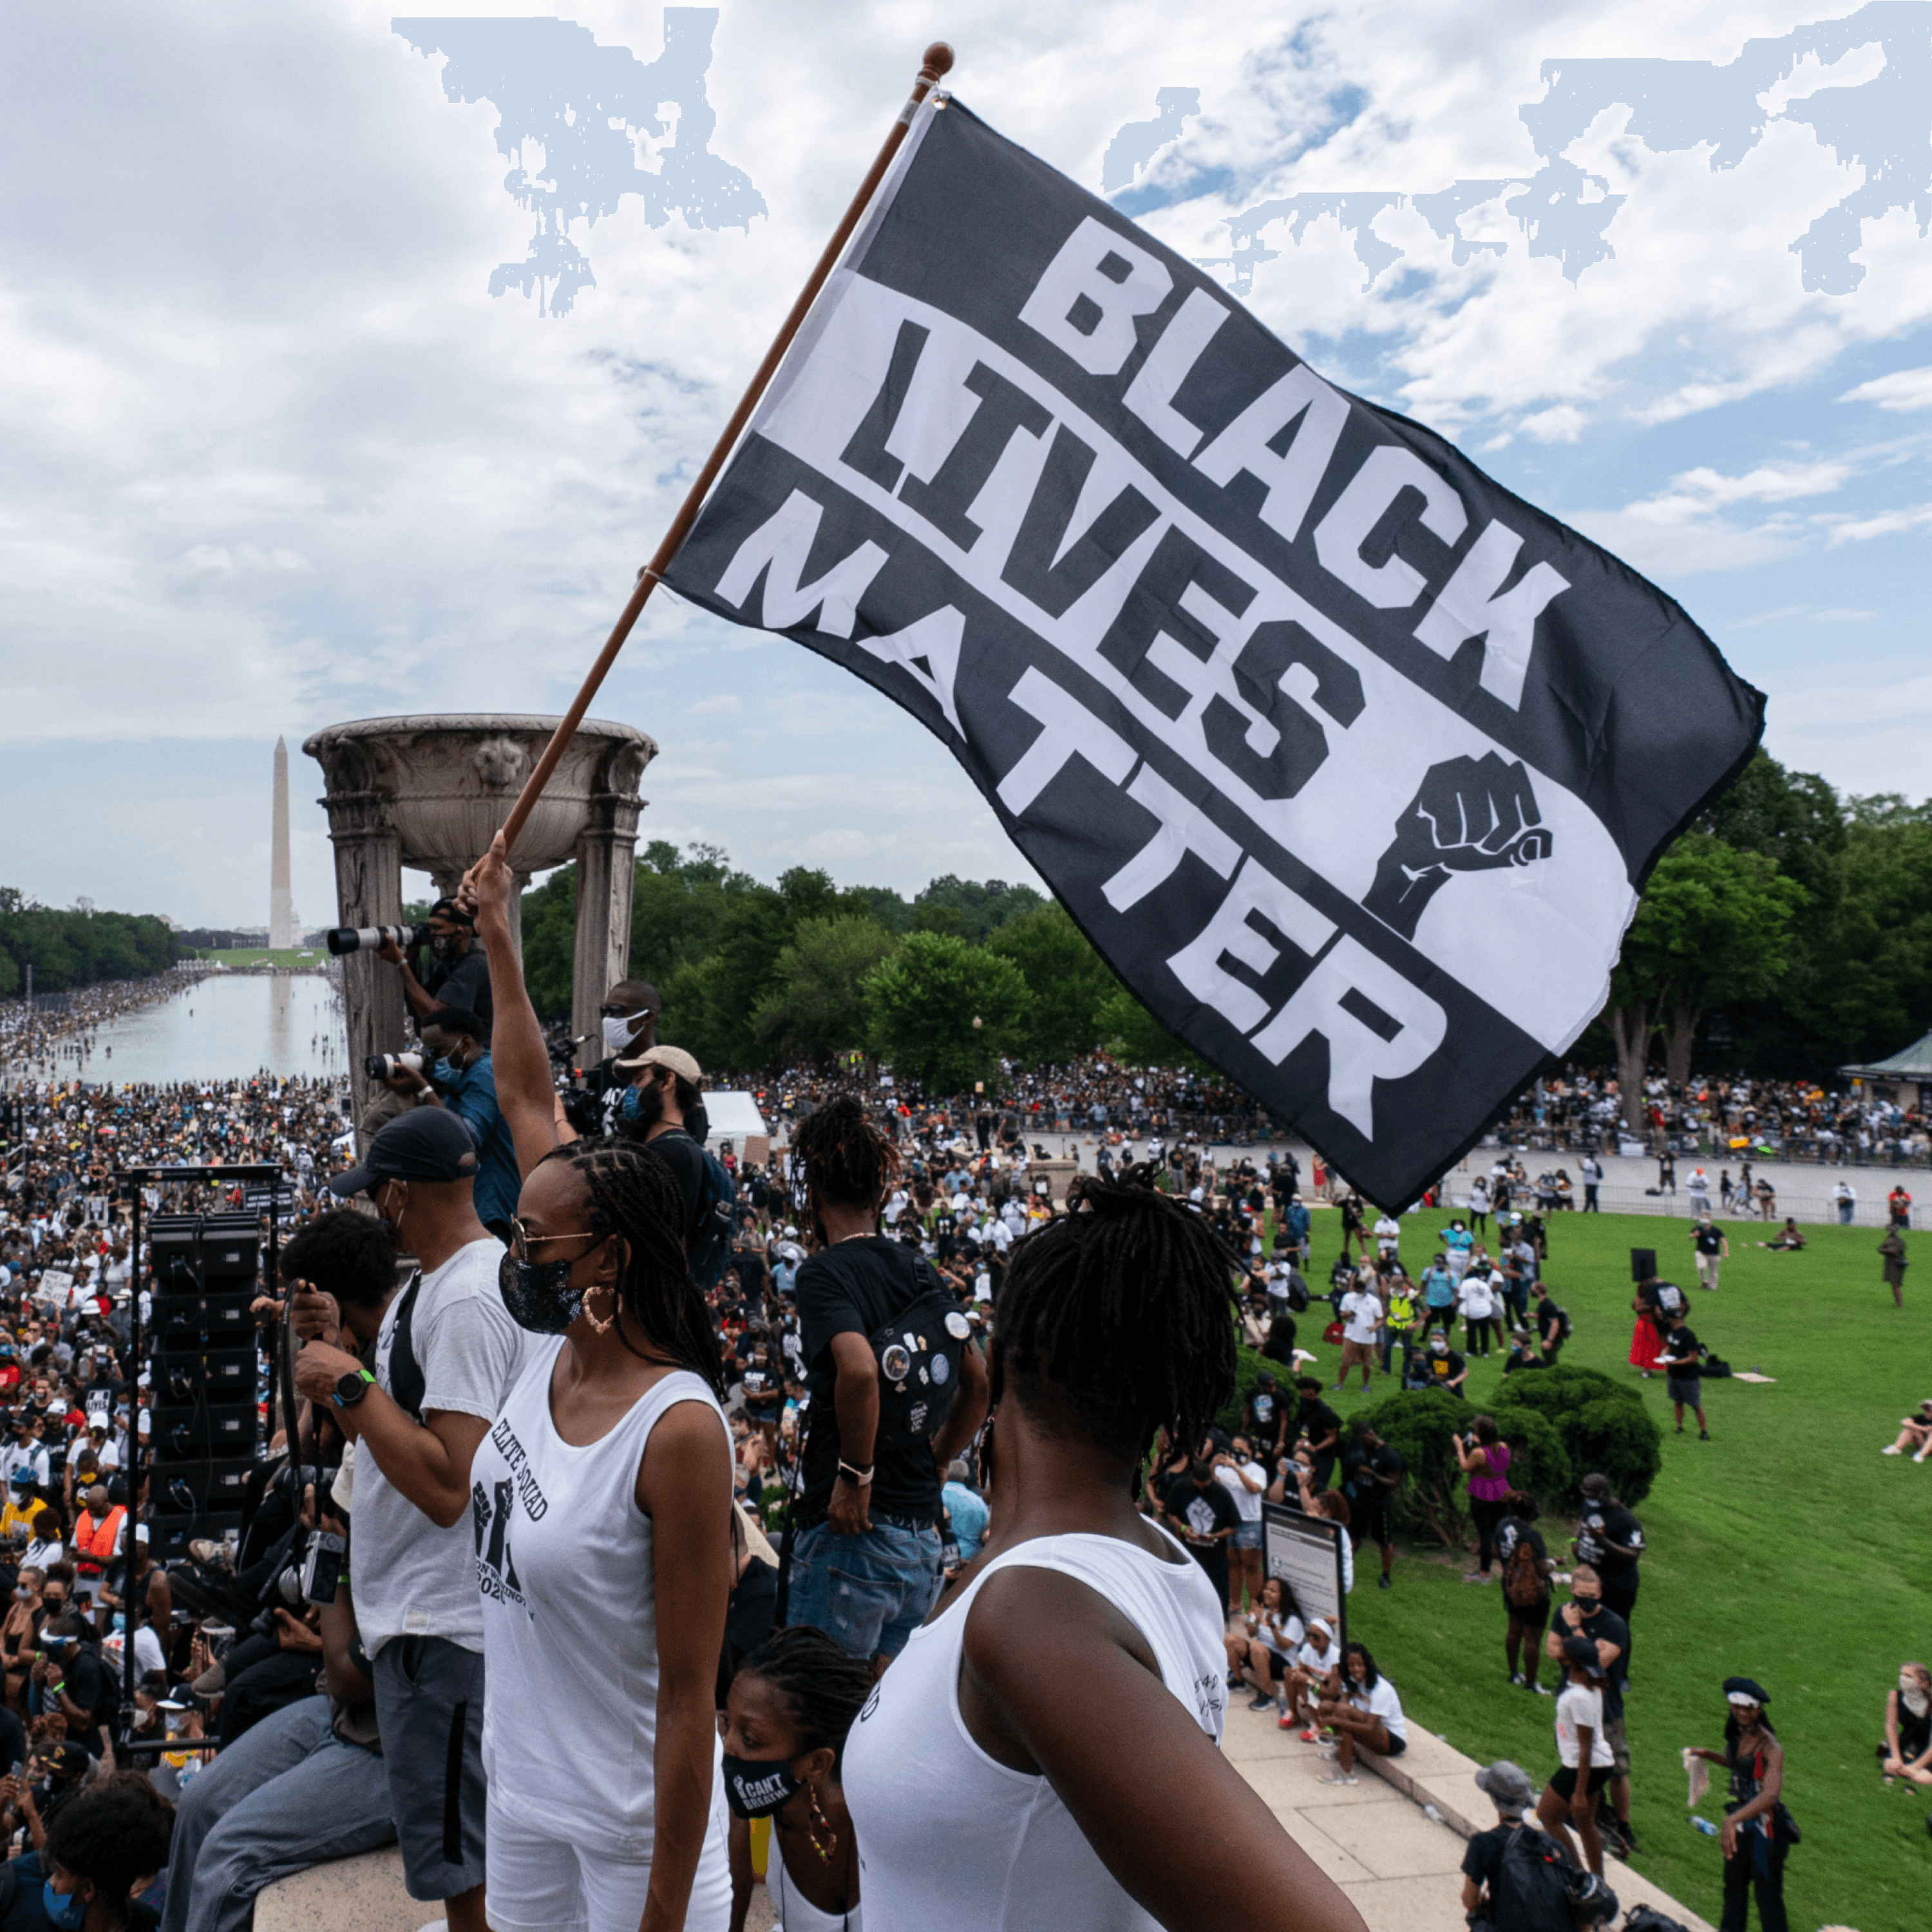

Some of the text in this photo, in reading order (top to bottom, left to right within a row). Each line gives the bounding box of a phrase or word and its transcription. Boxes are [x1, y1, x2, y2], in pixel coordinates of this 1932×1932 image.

[838, 318, 1367, 800] LIVES
[1018, 215, 1571, 712] BLACK
[714, 488, 1448, 1142] MATTER
[491, 1417, 548, 1522] ELITE SQUAD
[743, 1786, 790, 1810] BREATHE
[745, 1772, 781, 1798] CAN'T
